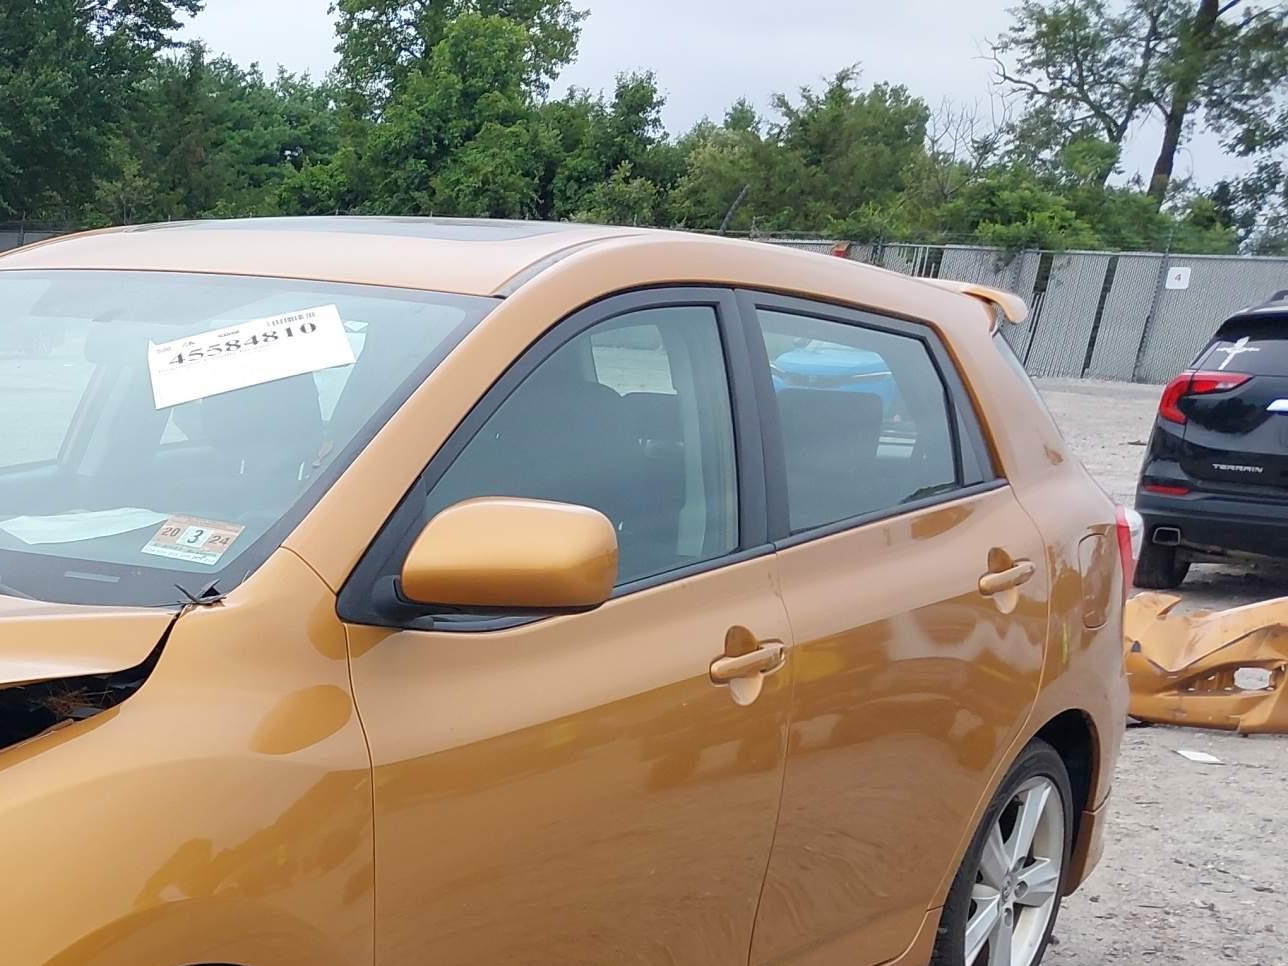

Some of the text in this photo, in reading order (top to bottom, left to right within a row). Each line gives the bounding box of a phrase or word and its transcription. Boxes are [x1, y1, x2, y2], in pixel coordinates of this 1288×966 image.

[168, 322, 317, 365] 45584810
[1212, 463, 1263, 473] TERRAIN
[161, 527, 231, 546] 20 3 24
